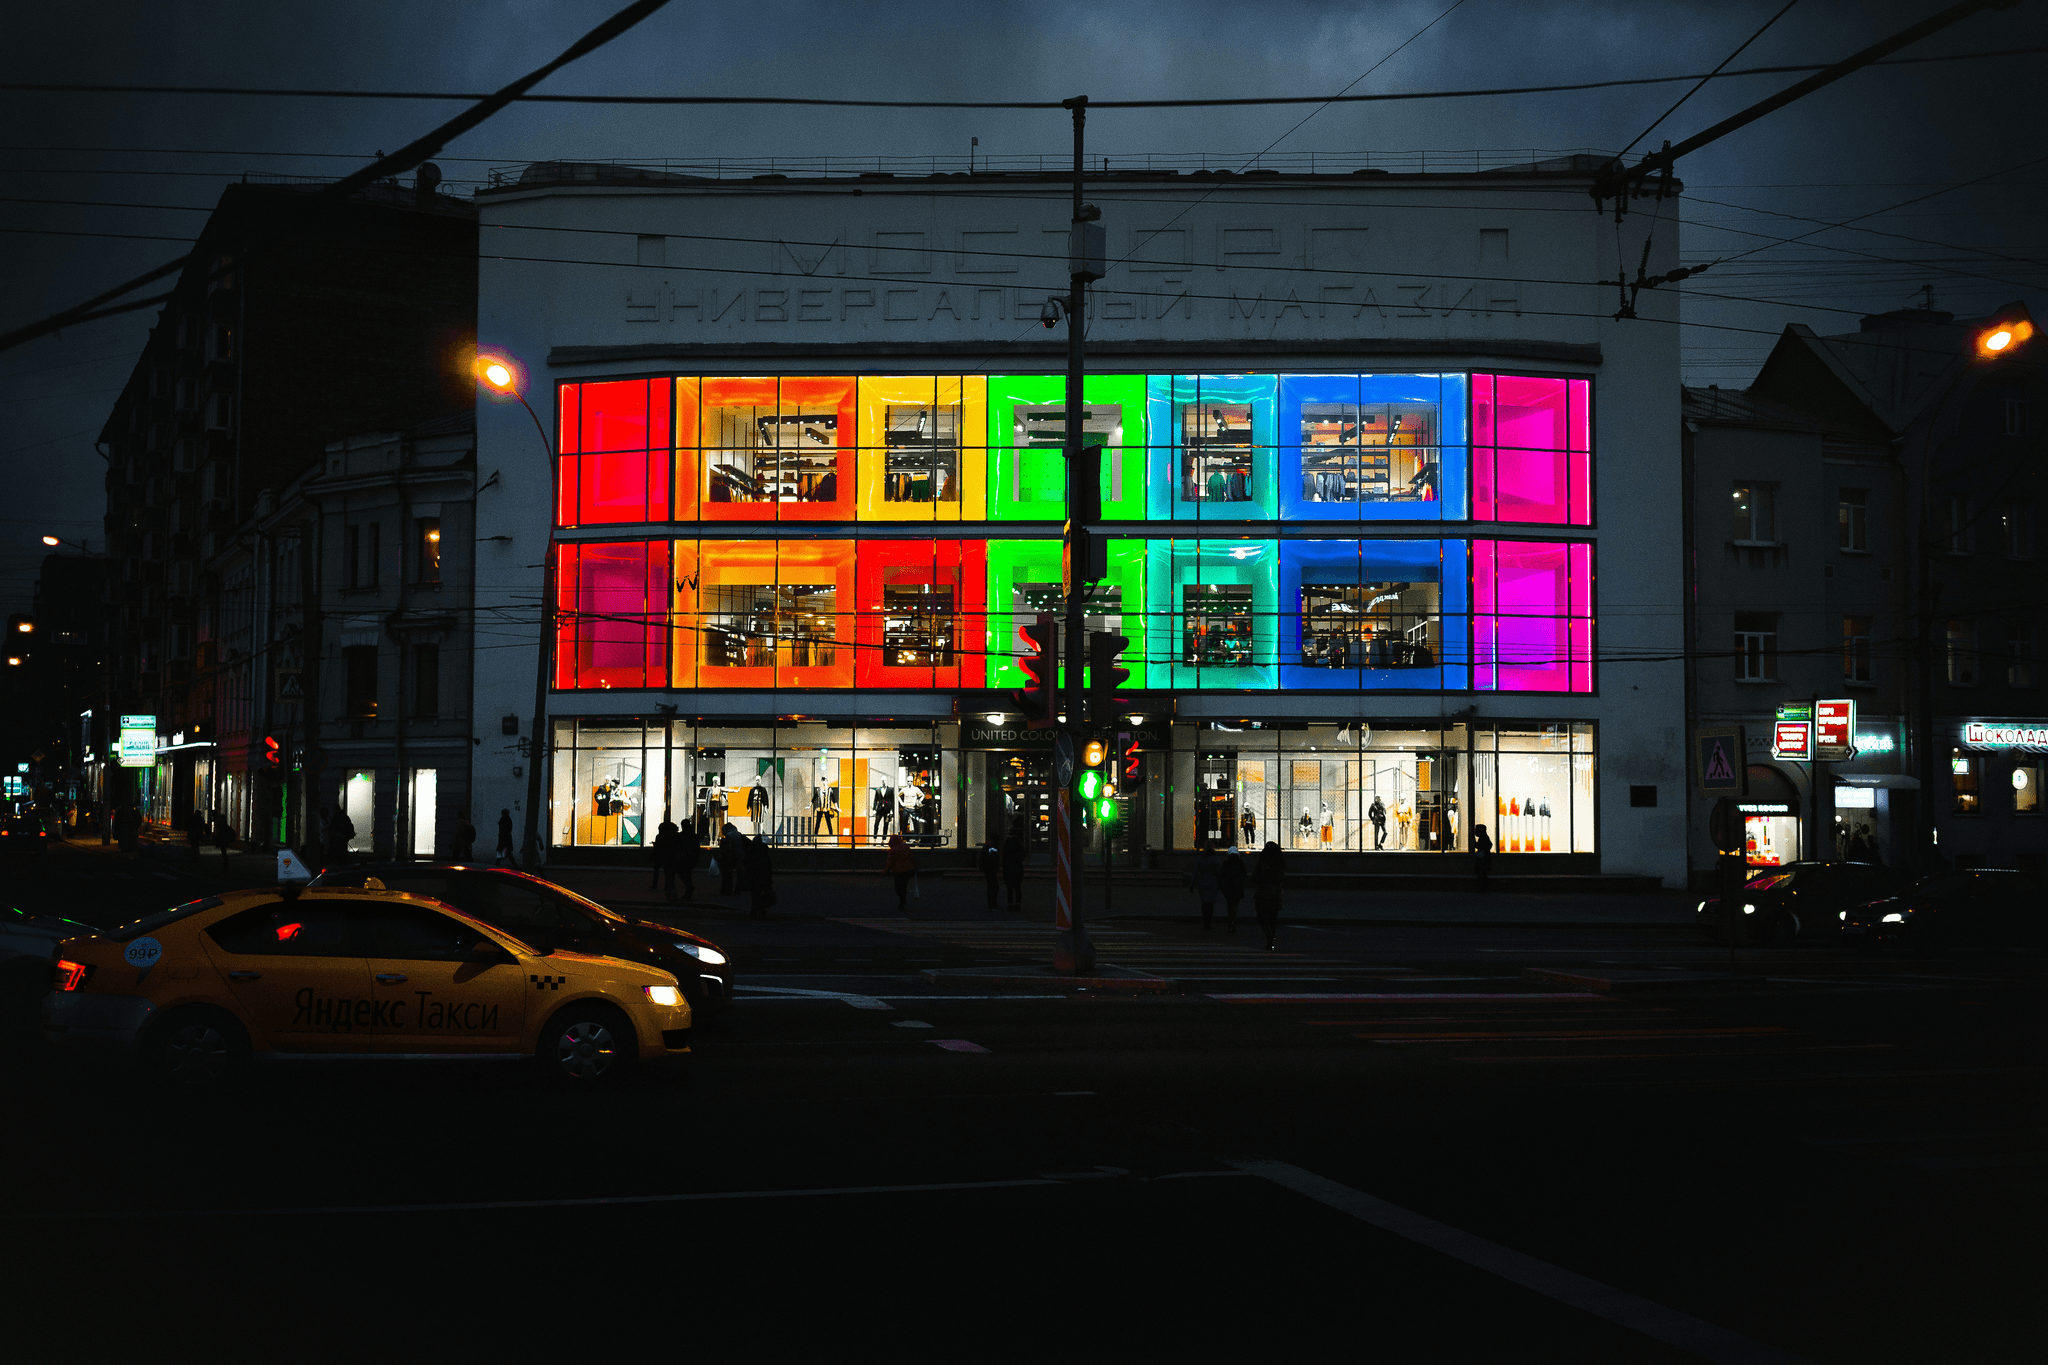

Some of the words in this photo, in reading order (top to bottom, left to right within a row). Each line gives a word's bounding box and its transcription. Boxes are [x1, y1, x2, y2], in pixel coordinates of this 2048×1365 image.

[772, 224, 1369, 276] МОСОРГ
[1229, 284, 1522, 318] МАГАЗИН
[971, 729, 1017, 741] UNITED
[1019, 729, 1059, 741] COLO
[1968, 726, 2048, 745] ШОКОЛАД
[291, 987, 406, 1032] Яндекс
[413, 990, 499, 1031] Такси
